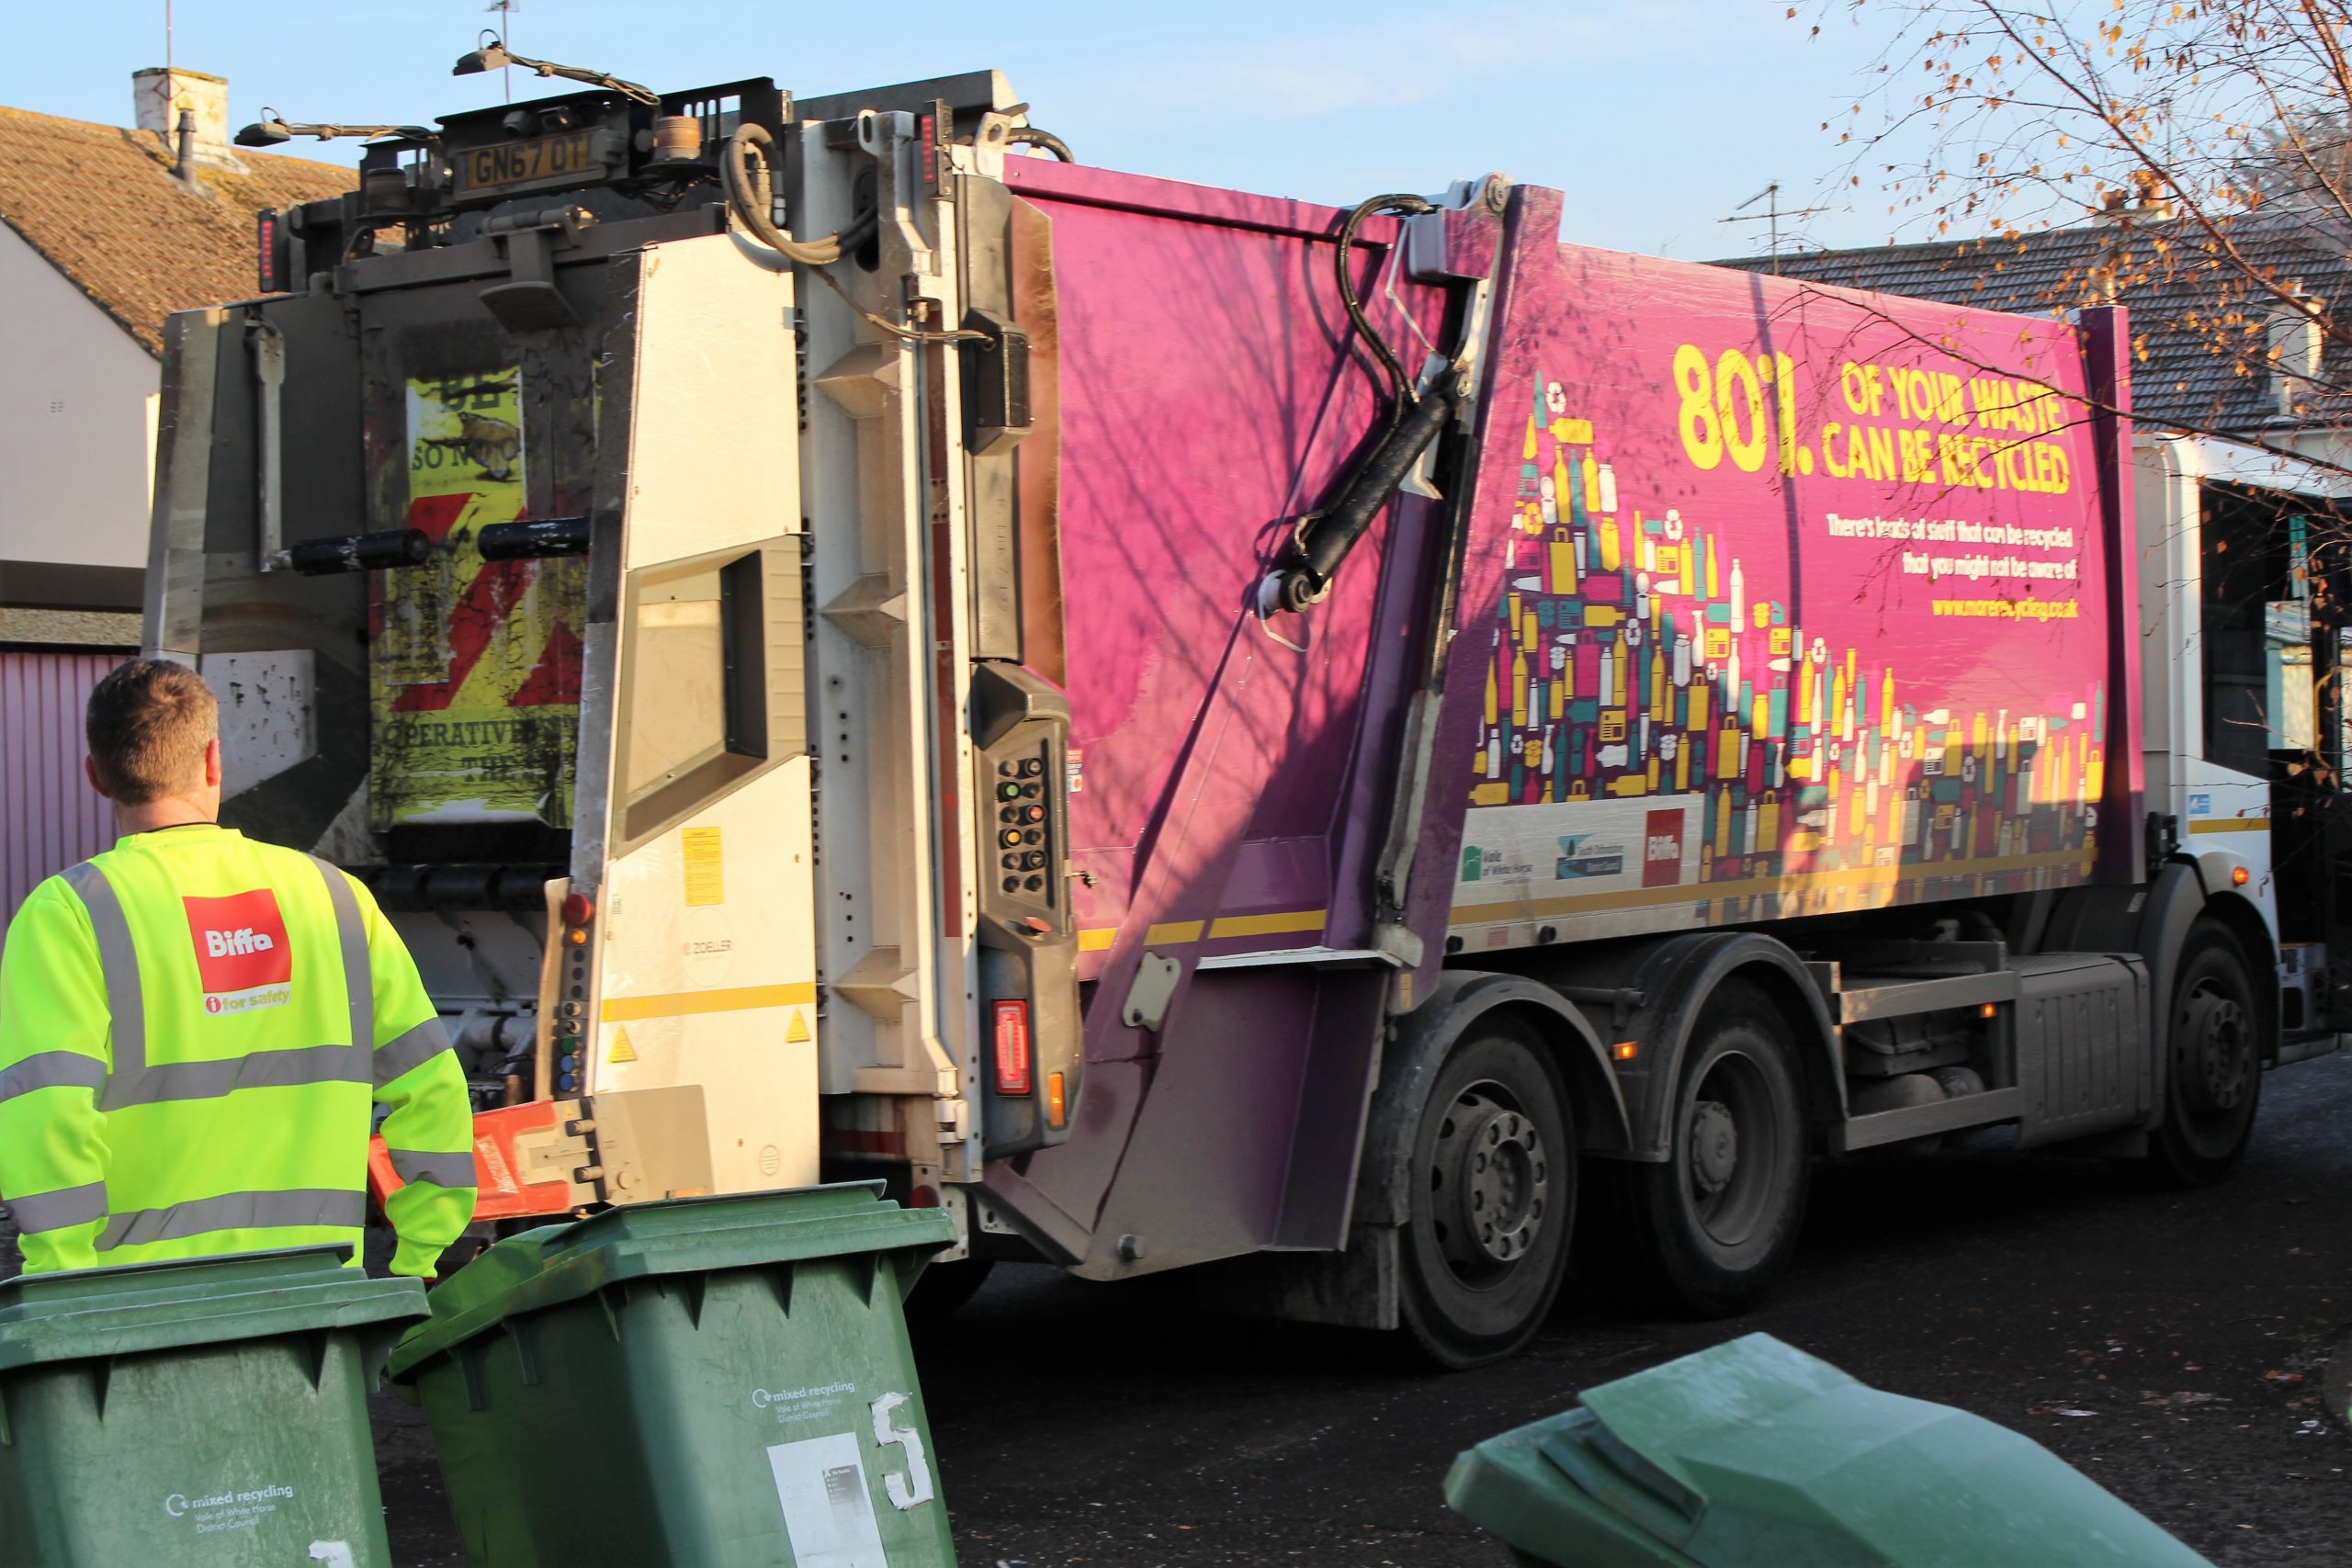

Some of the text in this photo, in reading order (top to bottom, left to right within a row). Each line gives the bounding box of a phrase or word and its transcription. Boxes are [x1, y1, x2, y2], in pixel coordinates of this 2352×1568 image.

[476, 134, 593, 183] GN67 OT
[1673, 343, 1813, 479] 80%
[1841, 361, 2065, 436] OF YOUR WASTE
[1822, 422, 2071, 495] CAN BE RECYCLED
[1826, 513, 2074, 551] There's loads of stuff that can be recycled
[1903, 551, 2077, 581] that you might not be aware of
[1483, 850, 1503, 863] Vale
[1646, 835, 1680, 862] Biffa
[205, 927, 274, 958] Biffa
[222, 998, 246, 1010] for
[249, 989, 290, 1007] safety
[773, 1381, 855, 1402] mixed recycling
[775, 1404, 792, 1414] Vale
[793, 1402, 800, 1412] of
[801, 1400, 821, 1410] White
[778, 1410, 829, 1424] District Council
[192, 1484, 293, 1508] mixed recycling
[195, 1504, 277, 1523] Vale of White Horse
[198, 1517, 260, 1534] District Council
